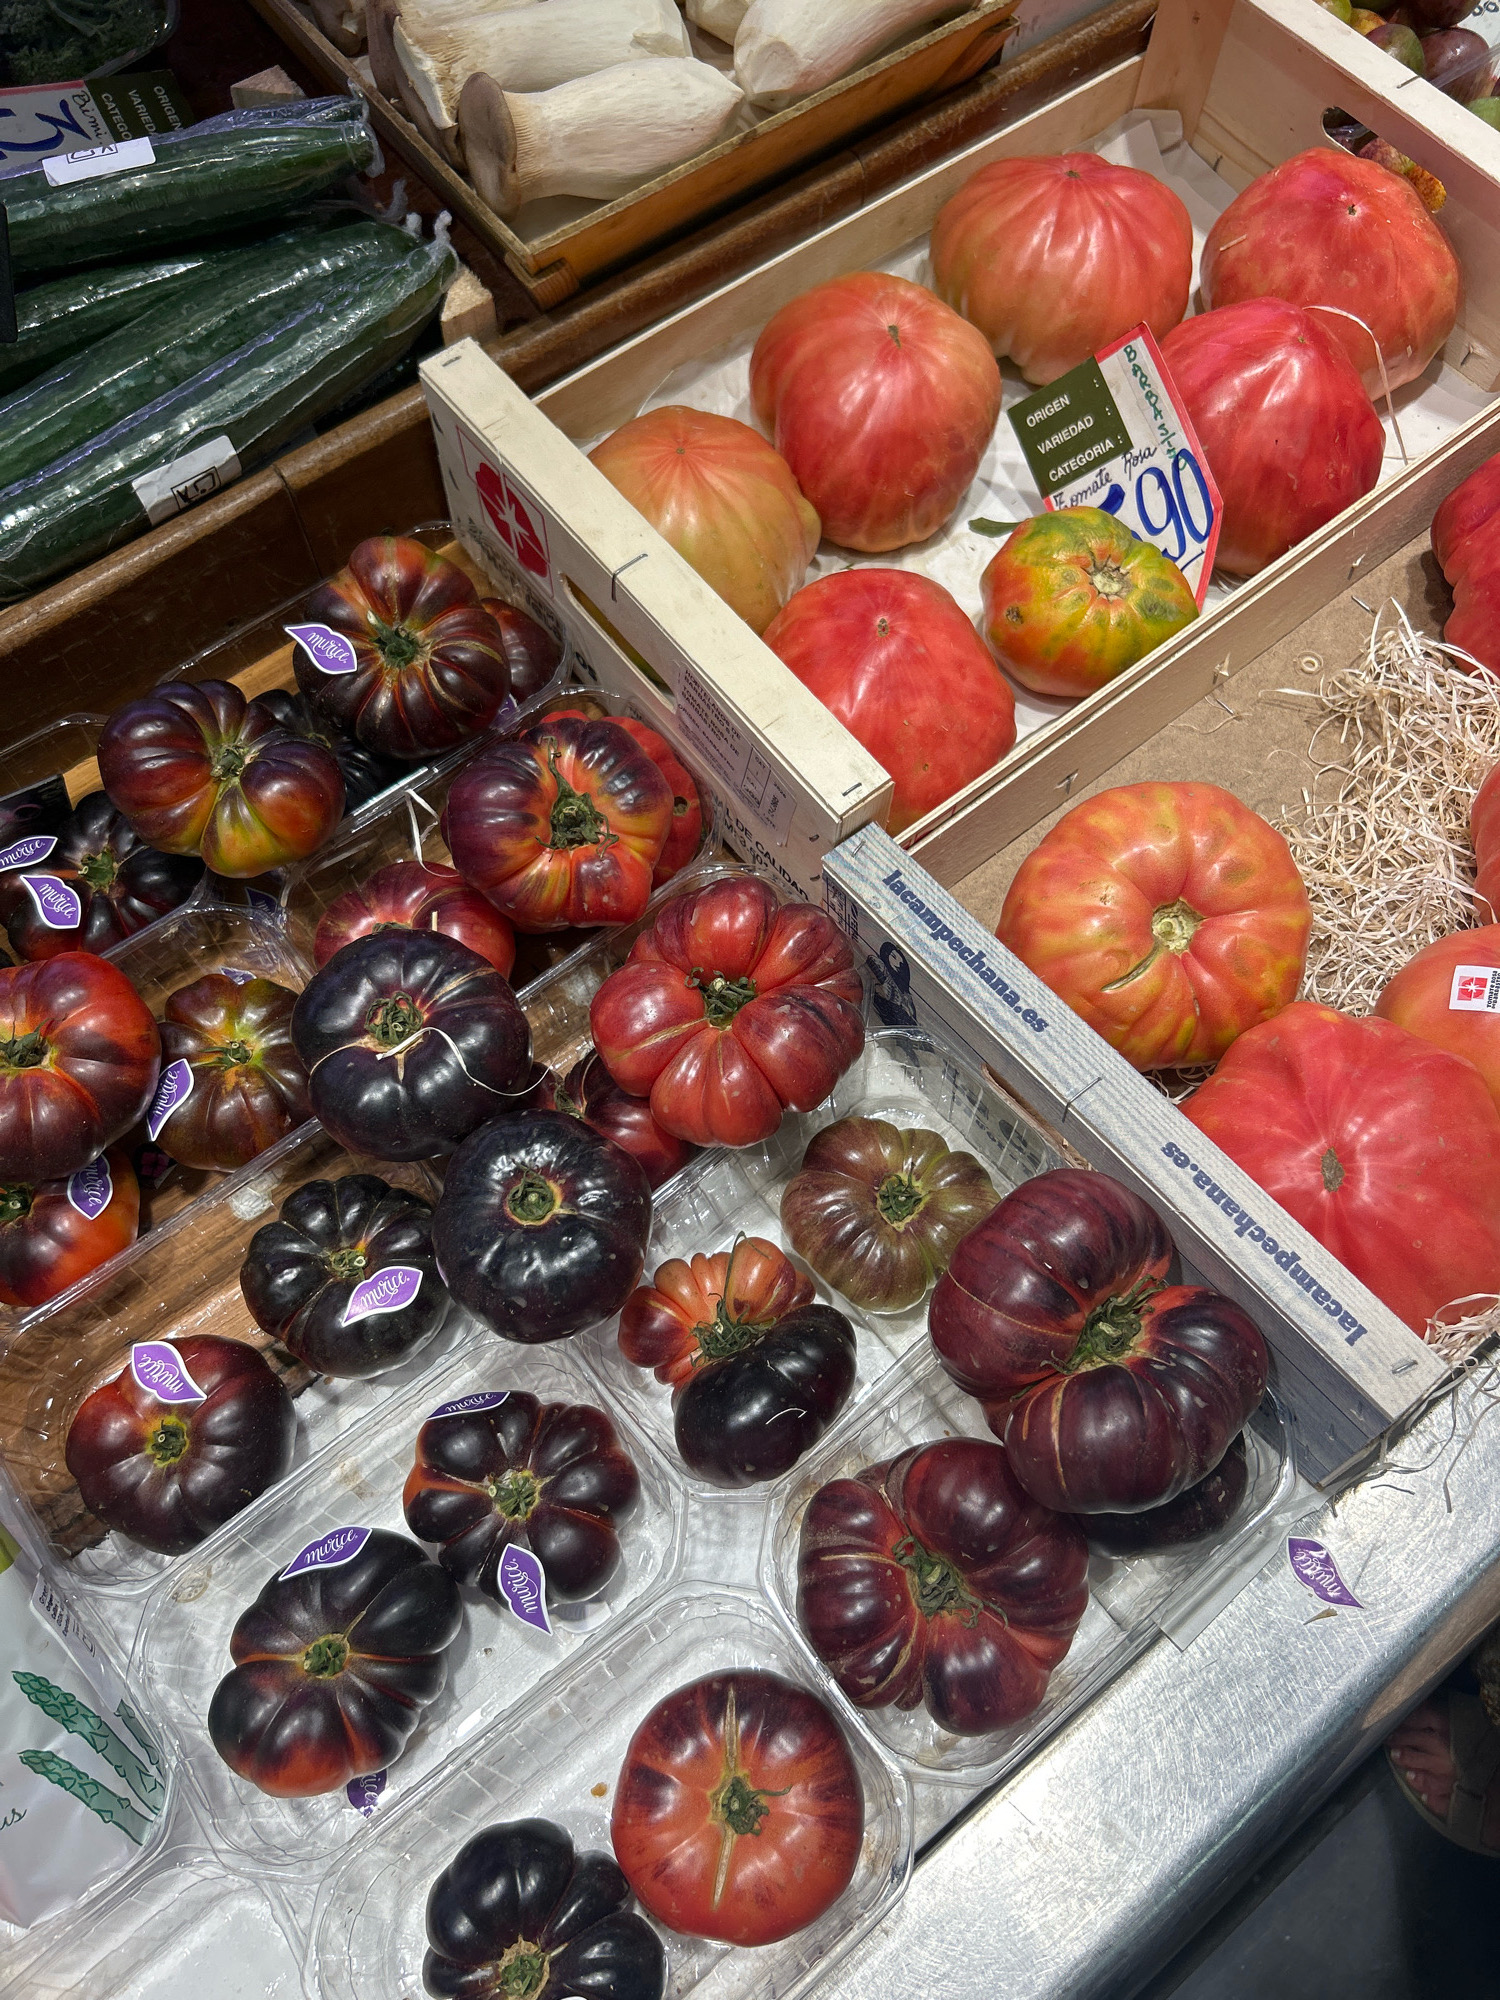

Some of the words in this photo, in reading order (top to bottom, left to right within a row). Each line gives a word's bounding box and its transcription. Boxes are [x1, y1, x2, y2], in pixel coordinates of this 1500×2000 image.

[101, 93, 133, 140] CATEGO
[154, 85, 184, 130] ORIGEN
[1026, 395, 1071, 428] ORIGEN
[1036, 415, 1094, 455] VARIEDAD
[1049, 439, 1115, 482] CATEGORIA
[1053, 468, 1112, 509] Tomate
[1121, 445, 1158, 481] Rosa
[306, 632, 350, 663] murice
[684, 676, 726, 728] BARBASTRO
[40, 884, 77, 919] murice
[882, 869, 1049, 1033] lacampechana.es
[153, 1070, 180, 1116] murice
[1160, 1141, 1368, 1347] lacampechana.es
[360, 1271, 410, 1307] murice
[138, 1354, 184, 1394] murice
[445, 1392, 496, 1412] murice
[304, 1529, 358, 1564] murice
[504, 1558, 539, 1614] murice
[1293, 1549, 1342, 1597] murice
